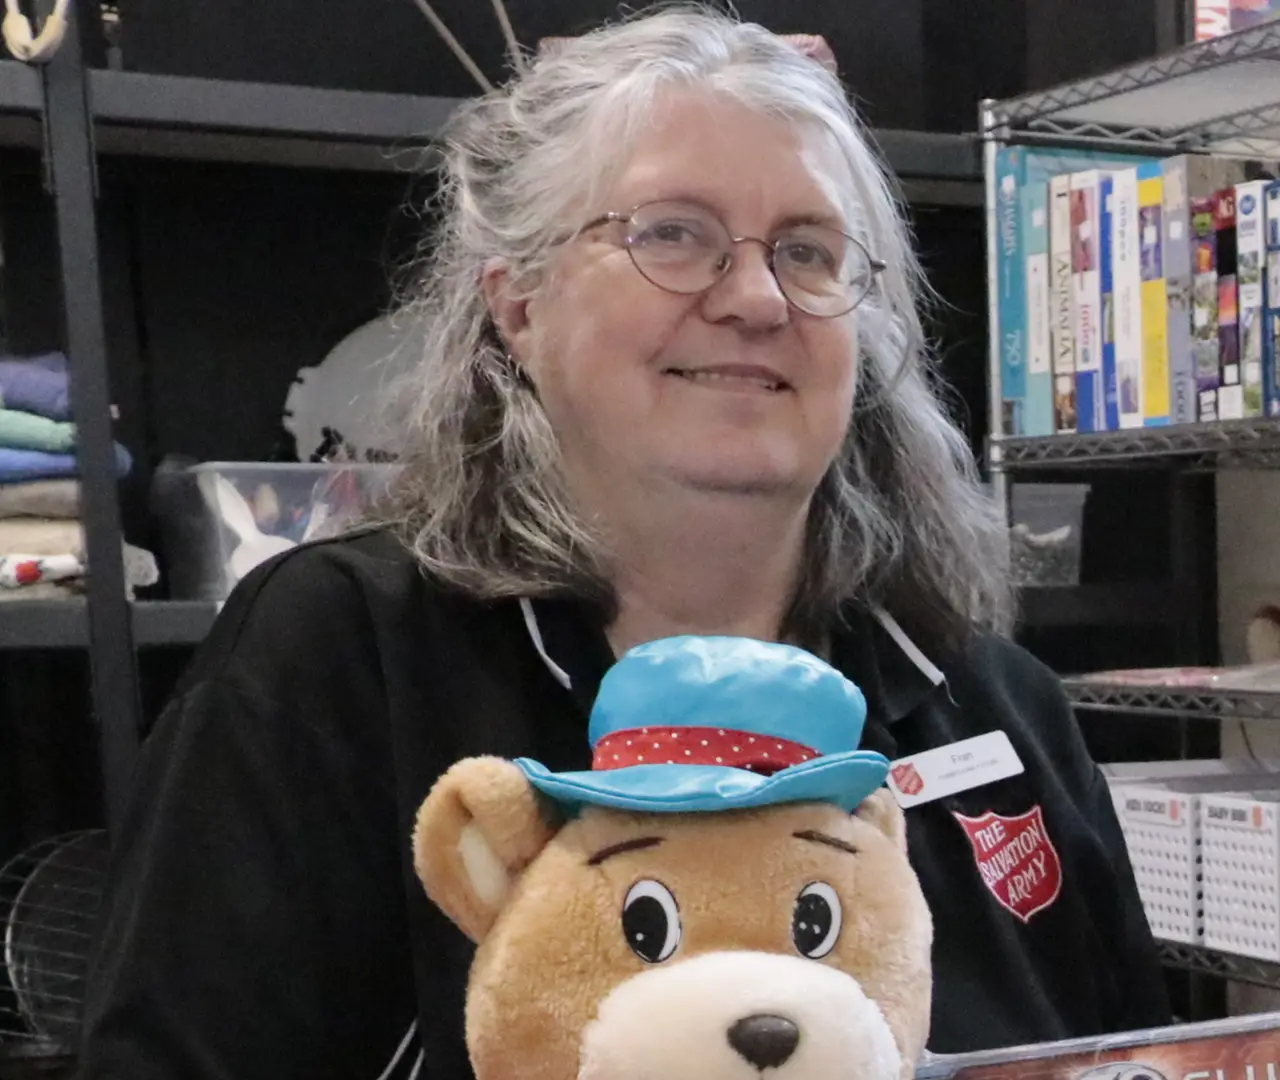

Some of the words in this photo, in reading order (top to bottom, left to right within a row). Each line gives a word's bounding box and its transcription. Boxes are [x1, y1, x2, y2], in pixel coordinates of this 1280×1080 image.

[1056, 258, 1070, 359] ANIMALIA
[975, 820, 1006, 852] THE
[979, 819, 1043, 886] SALVATION
[1006, 851, 1047, 906] ARMY
